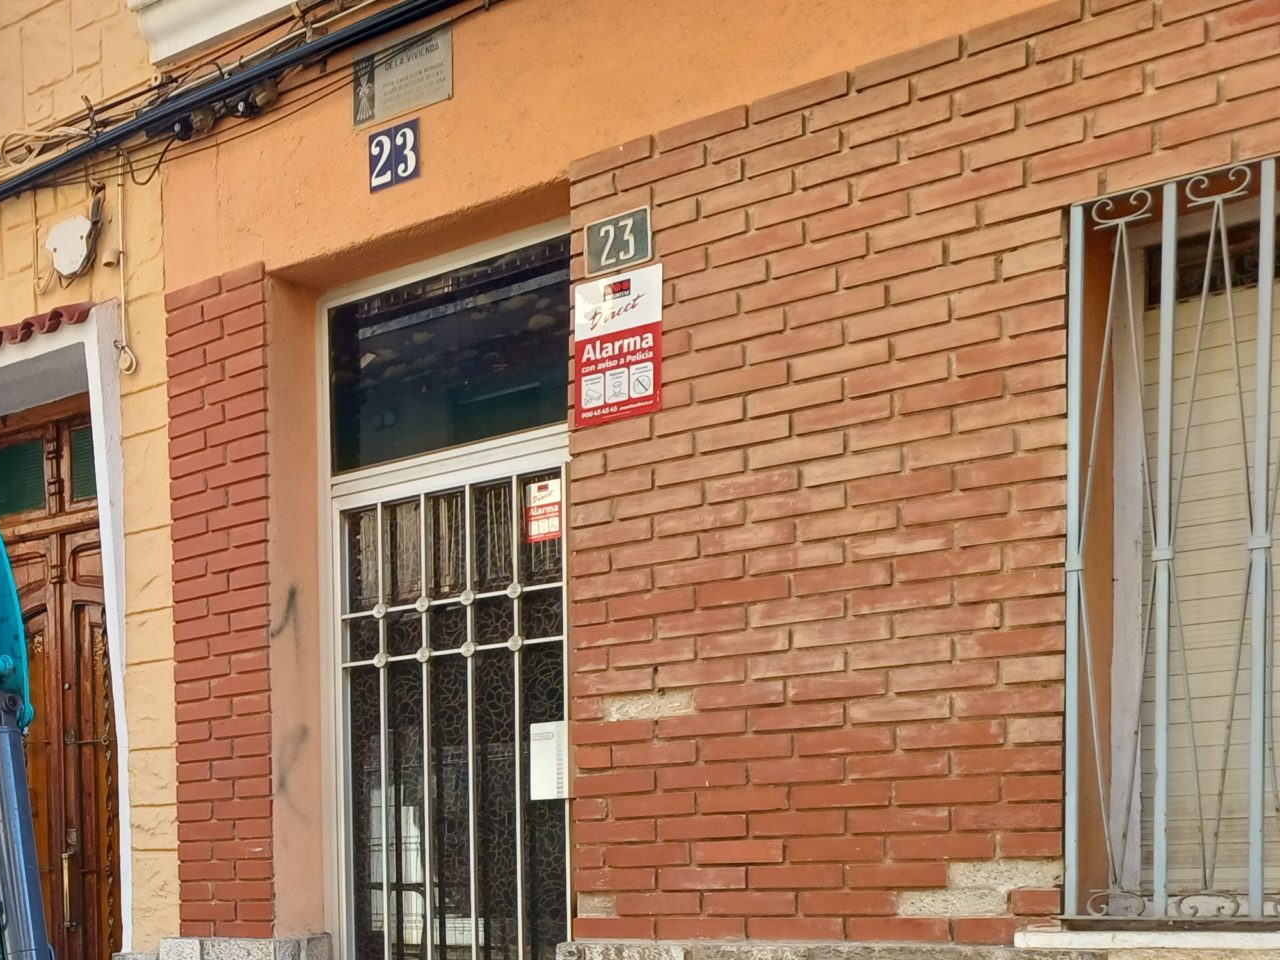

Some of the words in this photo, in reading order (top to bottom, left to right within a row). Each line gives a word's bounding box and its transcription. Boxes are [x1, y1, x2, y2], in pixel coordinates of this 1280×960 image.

[406, 42, 440, 62] VIVIENDA
[371, 127, 416, 187] 23
[600, 217, 635, 266] 23
[581, 332, 654, 364] Alarma
[581, 364, 596, 374] con
[597, 359, 618, 370] aviso
[619, 357, 625, 365] a
[625, 349, 654, 363] Policía
[581, 411, 594, 419] 900
[609, 405, 618, 413] 45
[528, 505, 559, 517] Alarma
